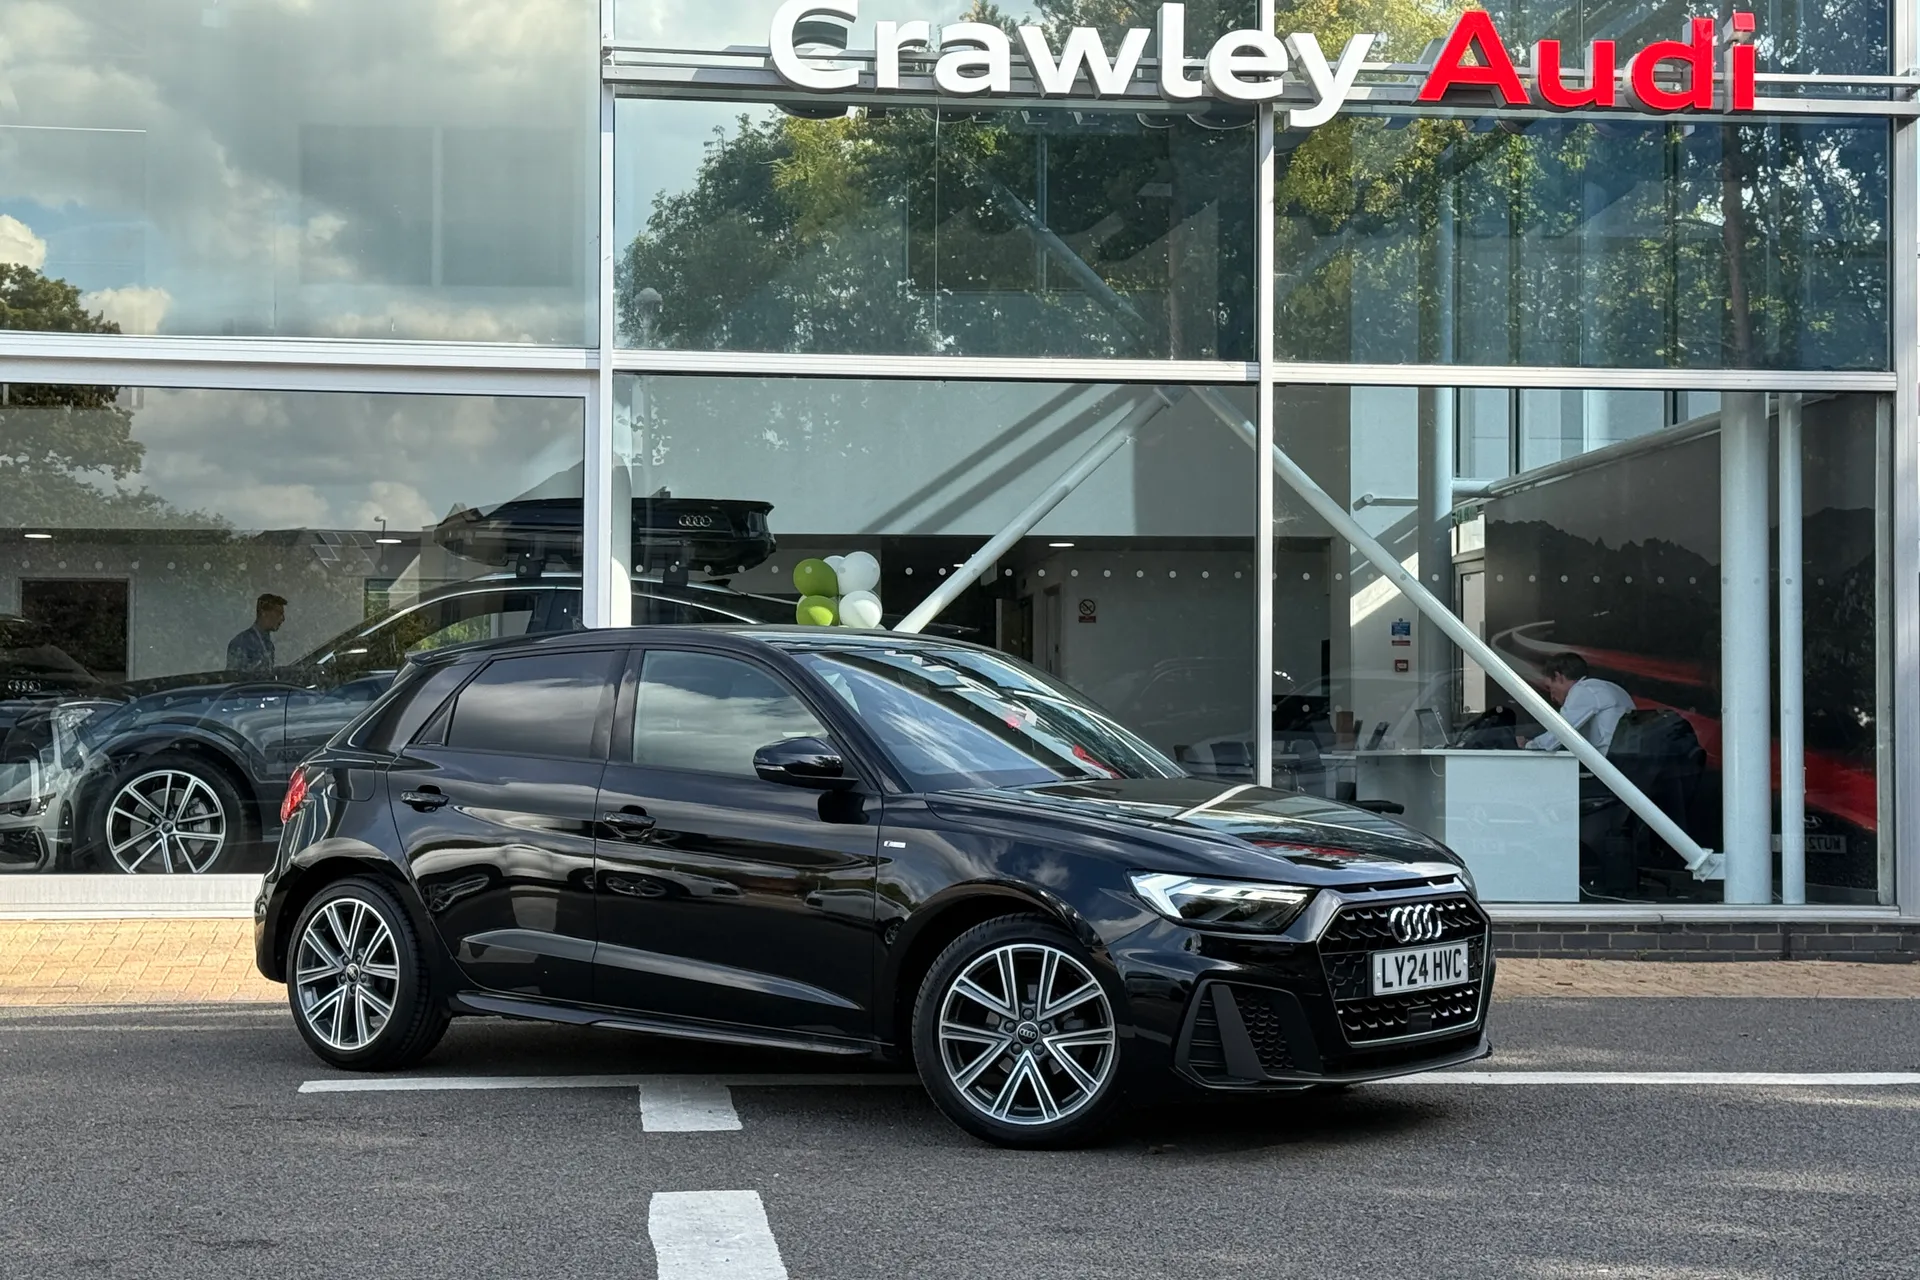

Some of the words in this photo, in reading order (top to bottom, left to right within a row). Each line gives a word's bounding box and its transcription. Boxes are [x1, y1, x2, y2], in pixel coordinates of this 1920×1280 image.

[769, 0, 1373, 127] Crawley
[1417, 10, 1756, 111] Audi
[1381, 953, 1429, 989] LY24
[1433, 948, 1462, 981] HVC
